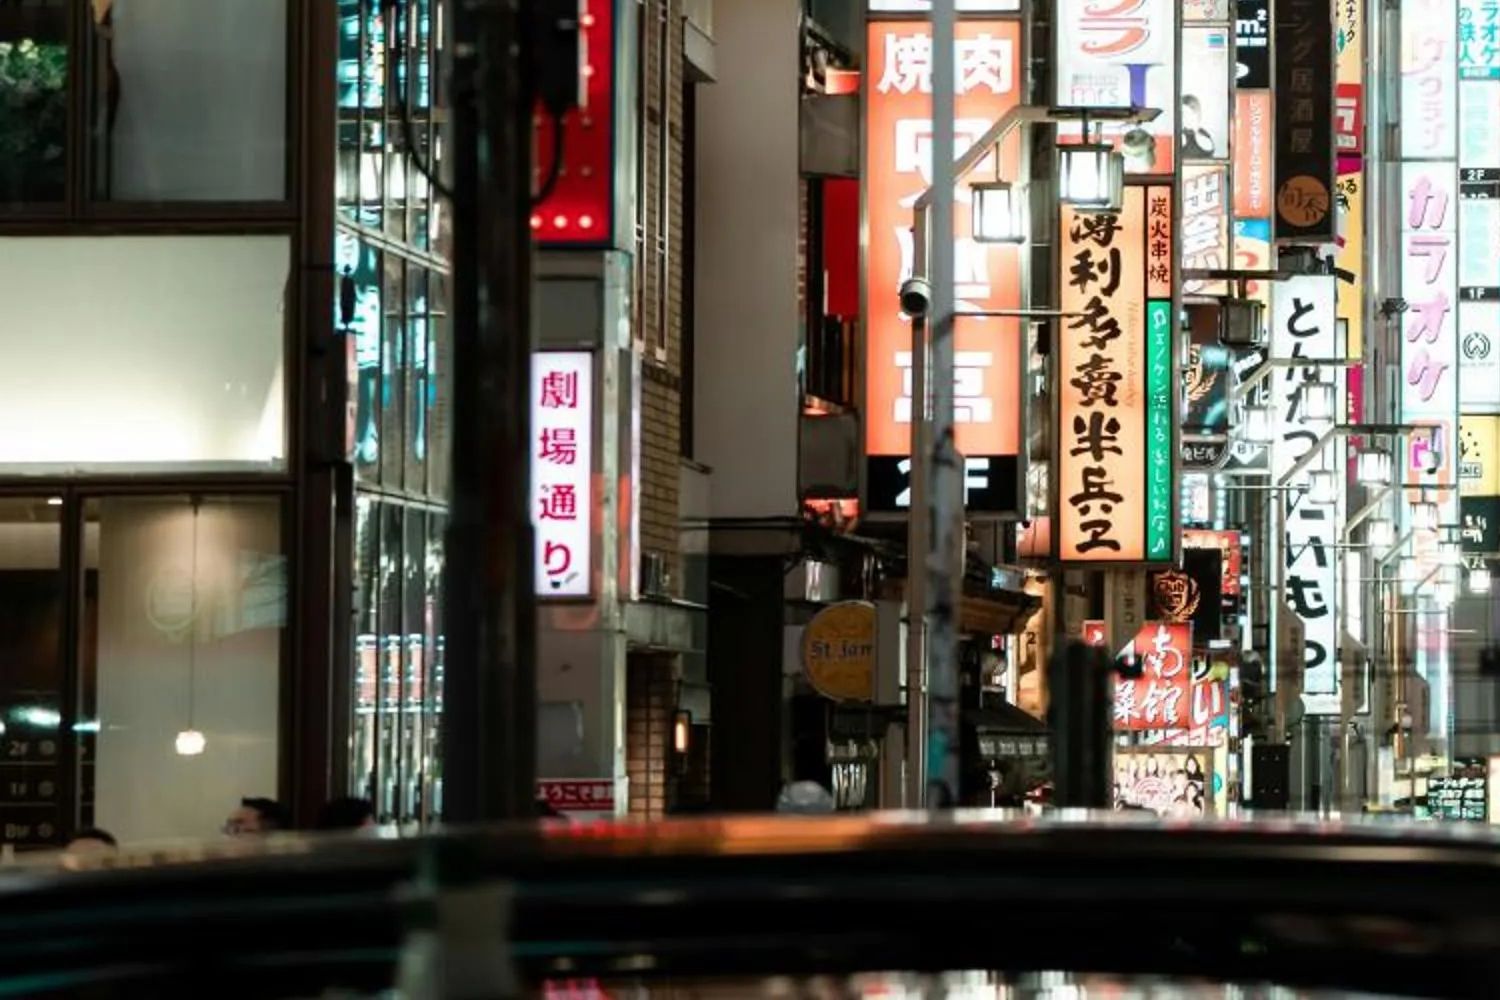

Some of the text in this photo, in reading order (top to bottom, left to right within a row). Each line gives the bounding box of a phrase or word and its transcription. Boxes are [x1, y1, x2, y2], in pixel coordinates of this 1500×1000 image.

[877, 33, 1012, 97] 焼肉
[1467, 169, 1485, 182] 2F
[1149, 195, 1170, 285] 炭火串焼
[1405, 174, 1450, 402] カラオケ
[1467, 287, 1486, 299] 1F
[538, 370, 579, 577] 劇場通り
